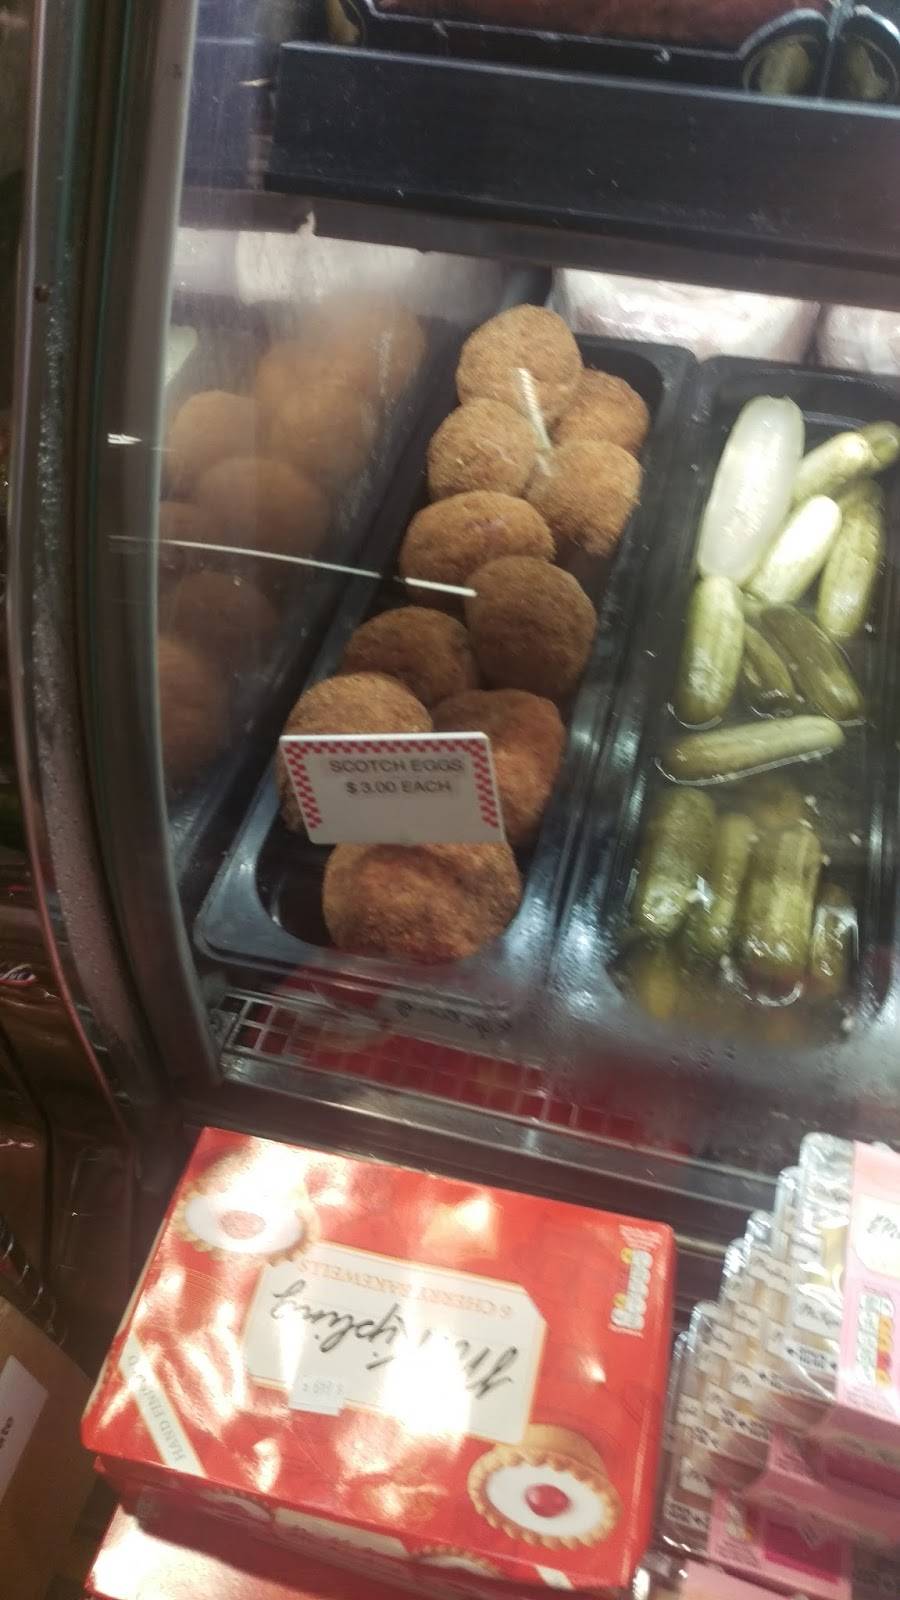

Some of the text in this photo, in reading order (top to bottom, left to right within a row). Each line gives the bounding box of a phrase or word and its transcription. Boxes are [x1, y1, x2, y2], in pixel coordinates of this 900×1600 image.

[329, 758, 465, 774] SCOTCH EGGS
[401, 779, 452, 793] EACH
[159, 1419, 187, 1462] HAND
